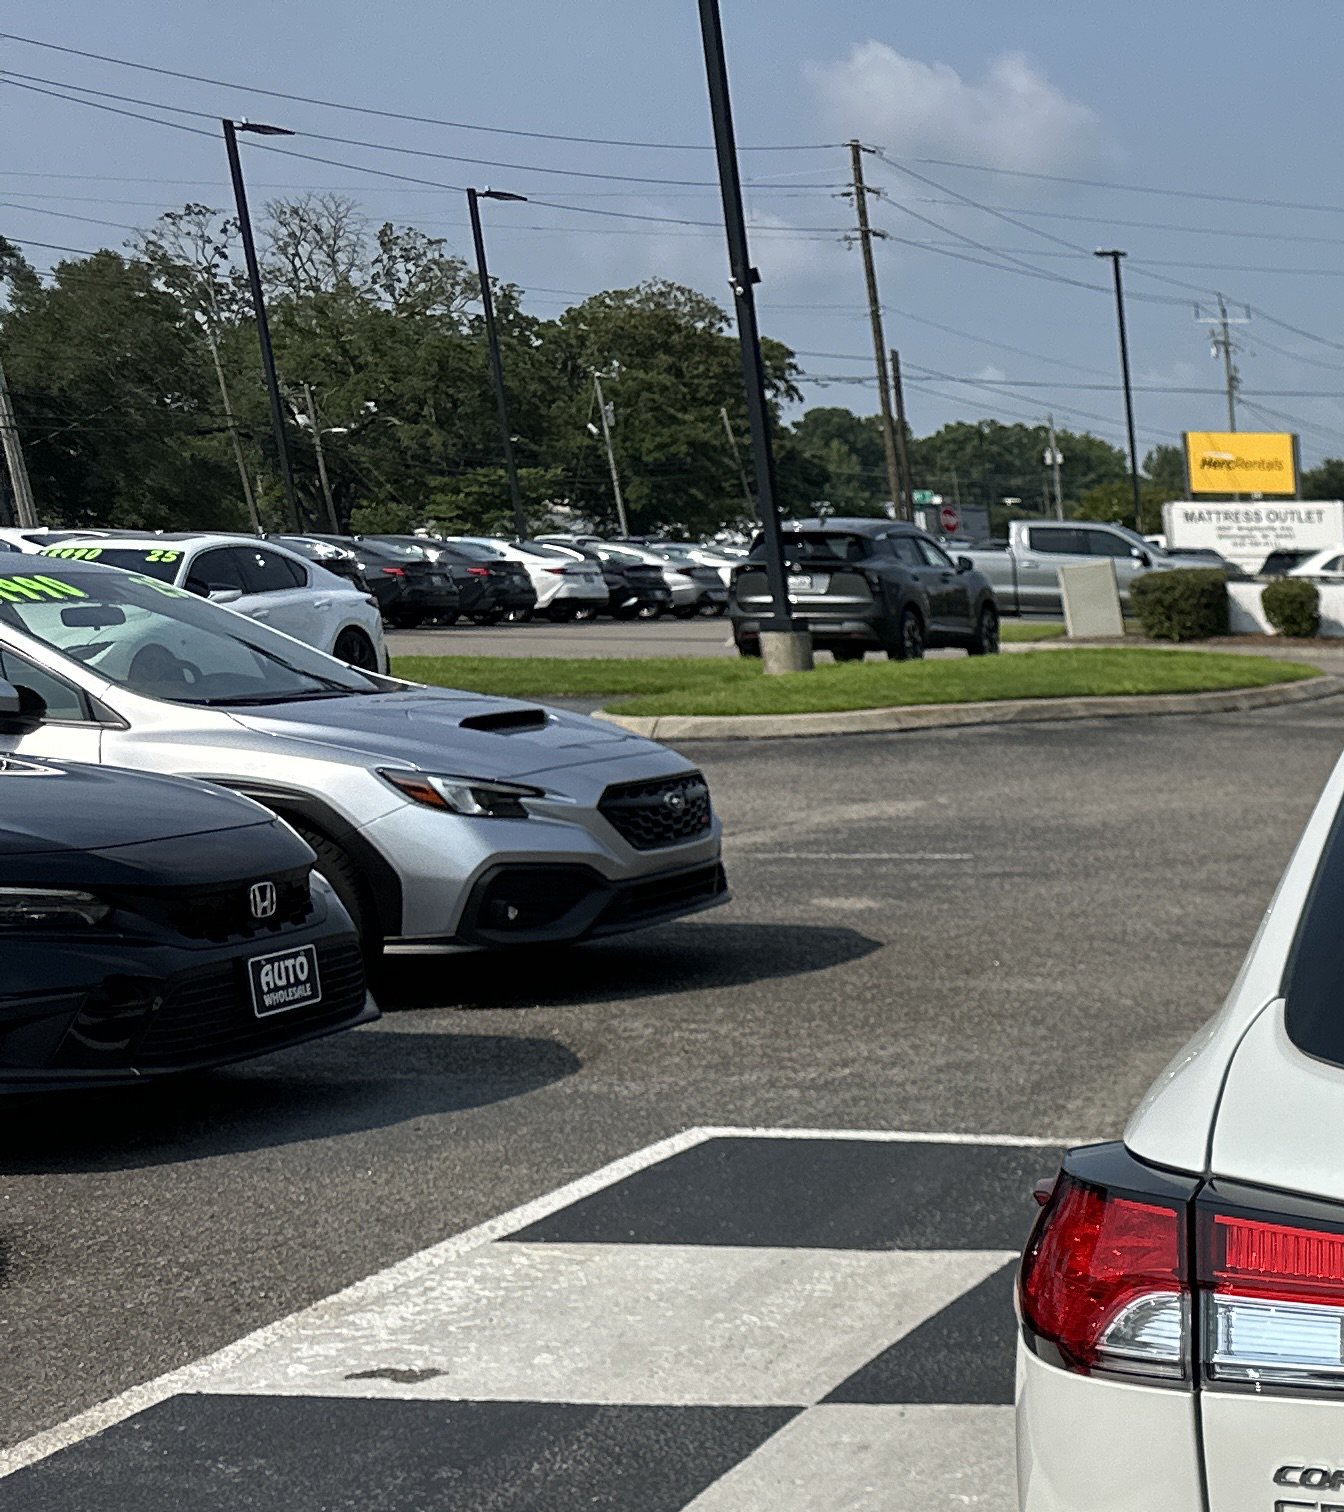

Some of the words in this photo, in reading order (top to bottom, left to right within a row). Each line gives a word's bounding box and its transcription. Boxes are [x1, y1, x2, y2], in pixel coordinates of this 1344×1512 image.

[1183, 509, 1263, 524] MATTRESS
[1265, 509, 1325, 524] OUTLET
[145, 549, 180, 563] 25
[260, 955, 309, 993] AUTO
[263, 982, 313, 1007] WHOLESALE
